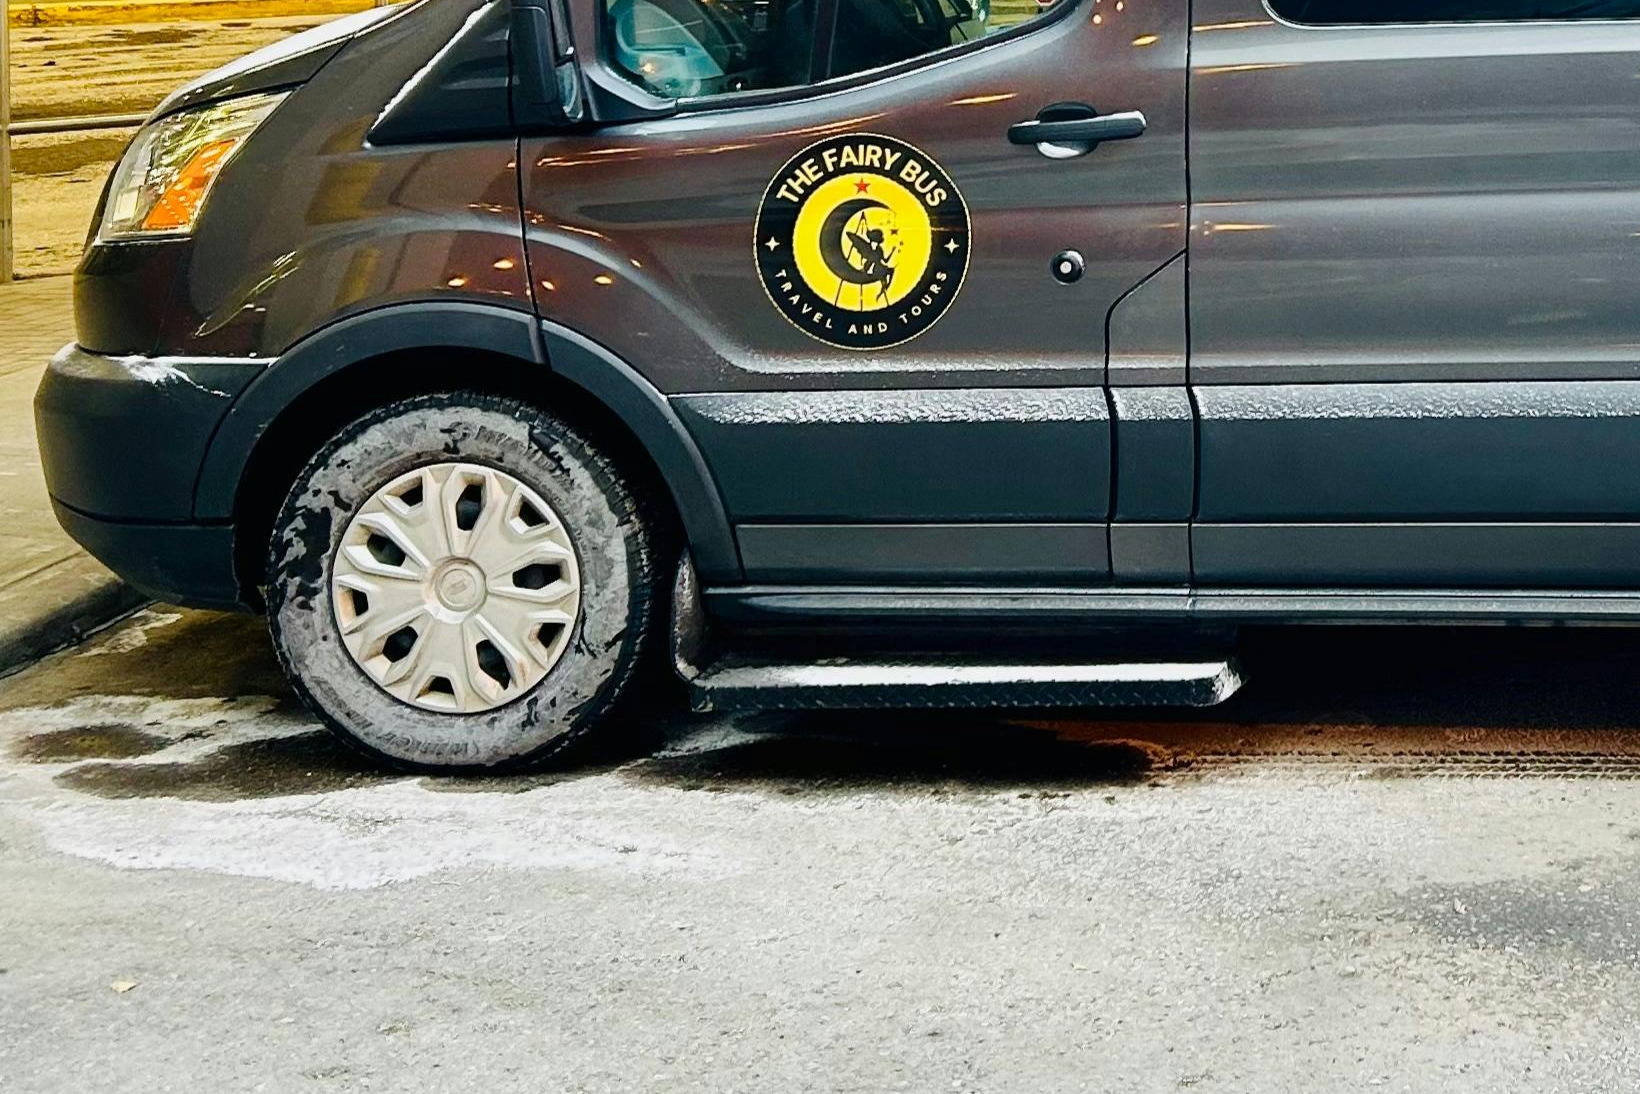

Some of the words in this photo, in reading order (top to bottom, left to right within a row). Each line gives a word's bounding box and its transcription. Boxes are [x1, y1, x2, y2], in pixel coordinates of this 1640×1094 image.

[776, 158, 823, 203] THE
[822, 144, 901, 172] FAIRY
[900, 159, 947, 206] BUS
[775, 269, 833, 329] TRAVEL
[848, 322, 888, 334] AND
[899, 272, 947, 324] TOURS
